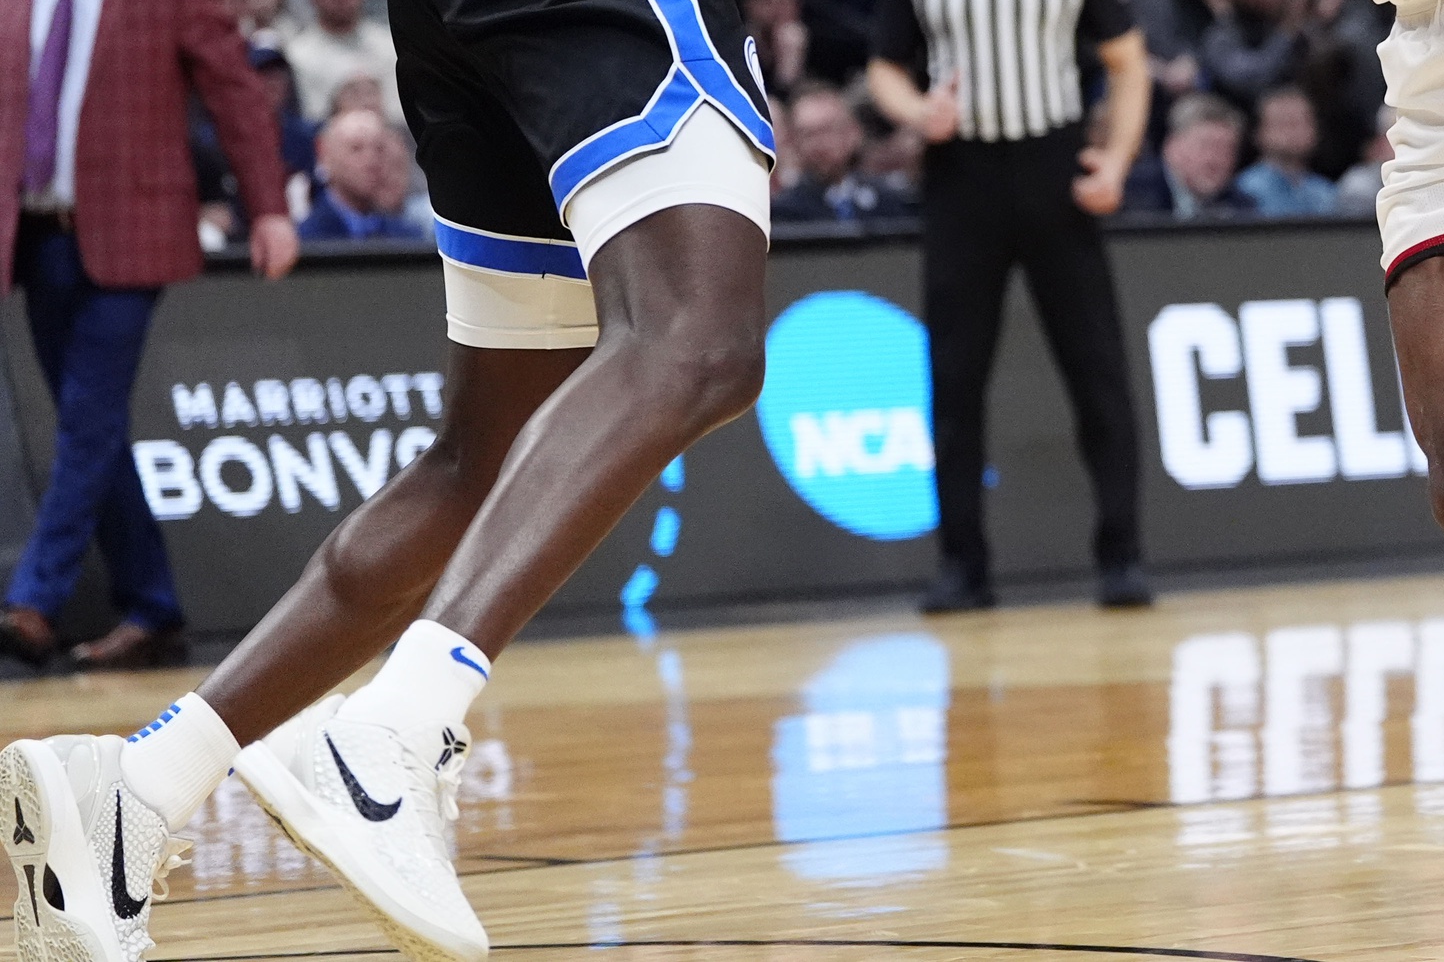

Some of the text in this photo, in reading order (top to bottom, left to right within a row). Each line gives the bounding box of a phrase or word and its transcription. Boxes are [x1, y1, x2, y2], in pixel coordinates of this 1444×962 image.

[170, 371, 444, 429] MARRIOTT
[131, 425, 437, 520] BONV
[790, 405, 936, 479] NCA
